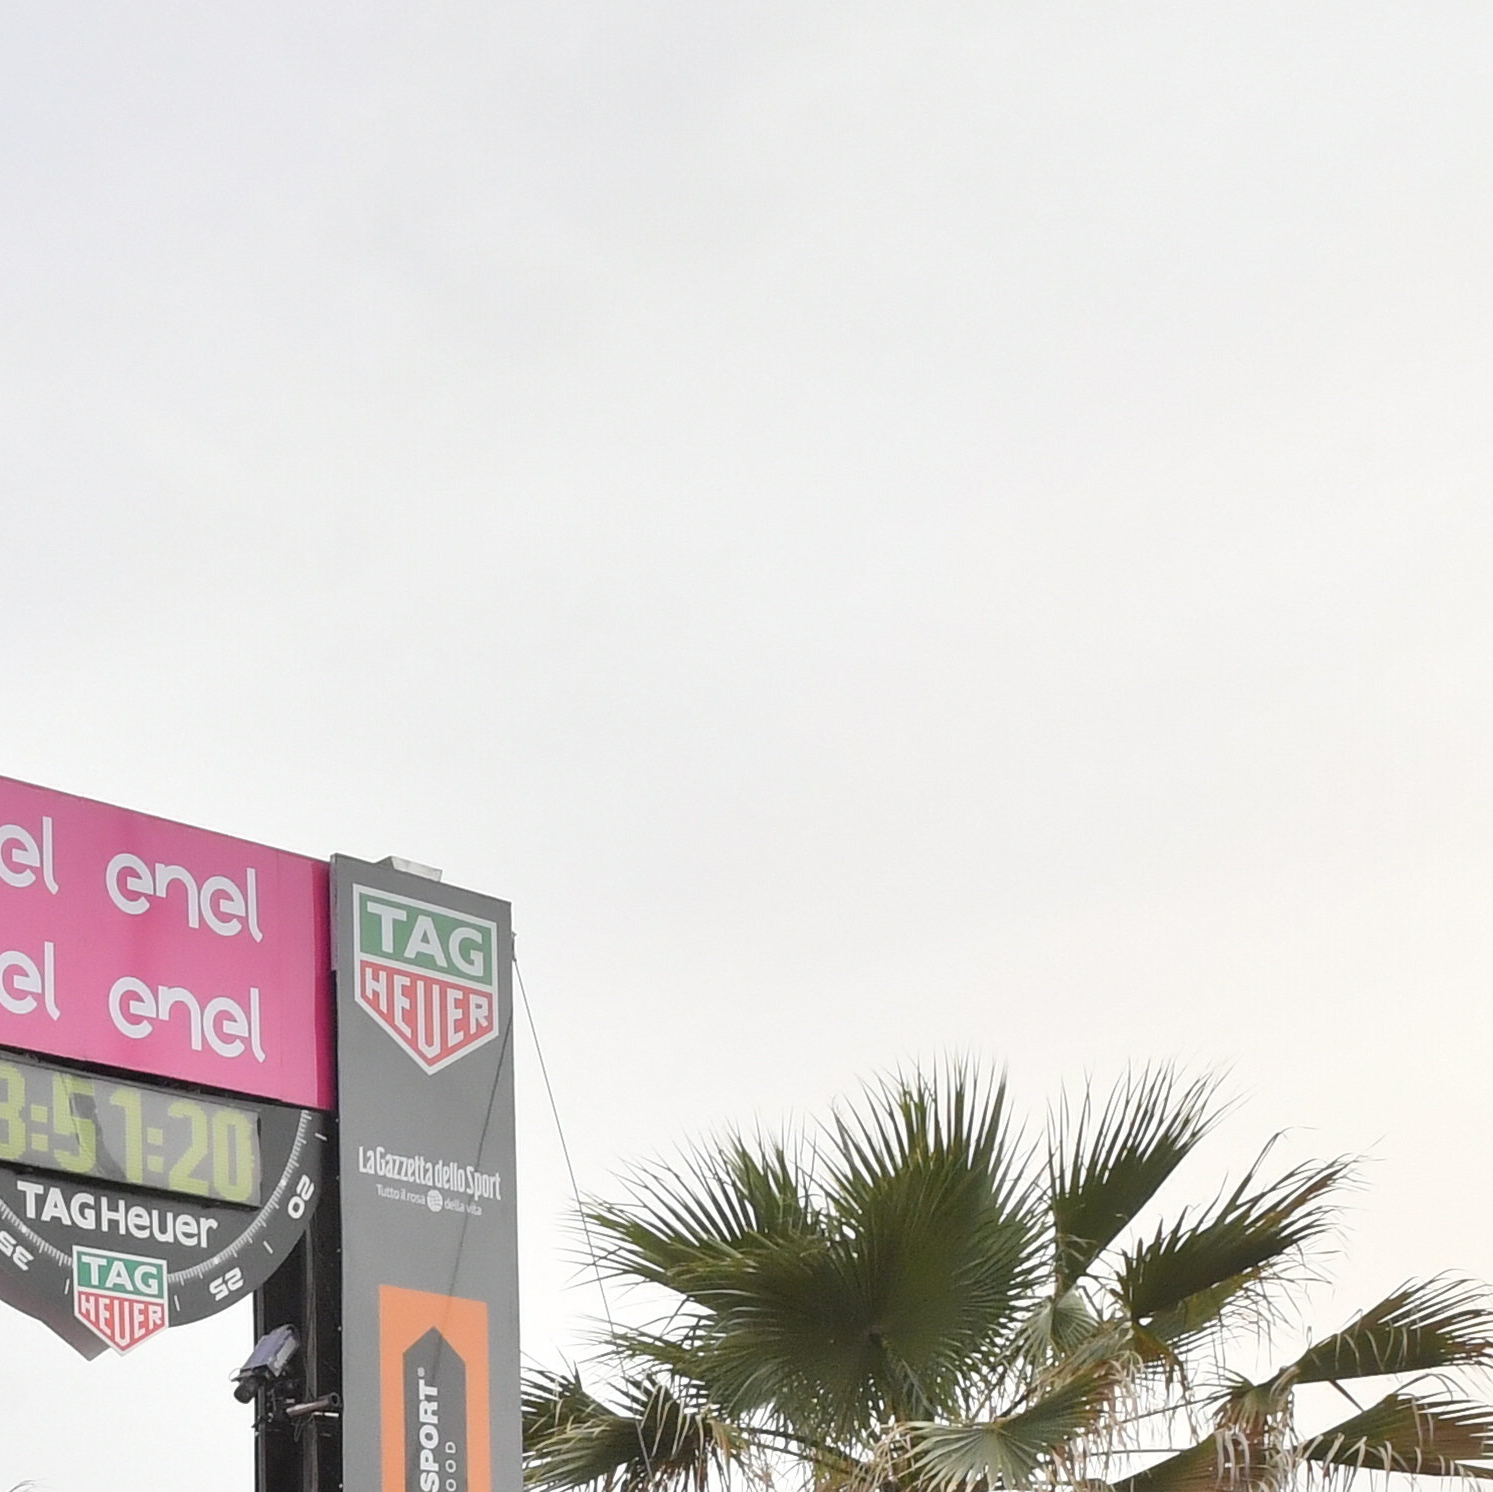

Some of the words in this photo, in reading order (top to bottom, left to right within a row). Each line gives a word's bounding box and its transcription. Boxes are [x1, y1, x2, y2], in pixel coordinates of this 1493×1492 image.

[106, 852, 265, 943] enel
[367, 901, 486, 969] TAG
[109, 976, 267, 1063] enel
[363, 967, 490, 1057] HEUER
[287, 1175, 315, 1219] 20
[376, 1146, 433, 1186] Gazzetta
[435, 1160, 465, 1192] dello
[466, 1166, 501, 1201] Sport
[376, 1184, 400, 1200] Tutto
[406, 1193, 426, 1205] rosa
[444, 1199, 465, 1213] della
[466, 1203, 482, 1216] vita
[81, 1255, 159, 1294] TAG
[209, 1266, 244, 1301] 25
[81, 1295, 162, 1345] HEUER
